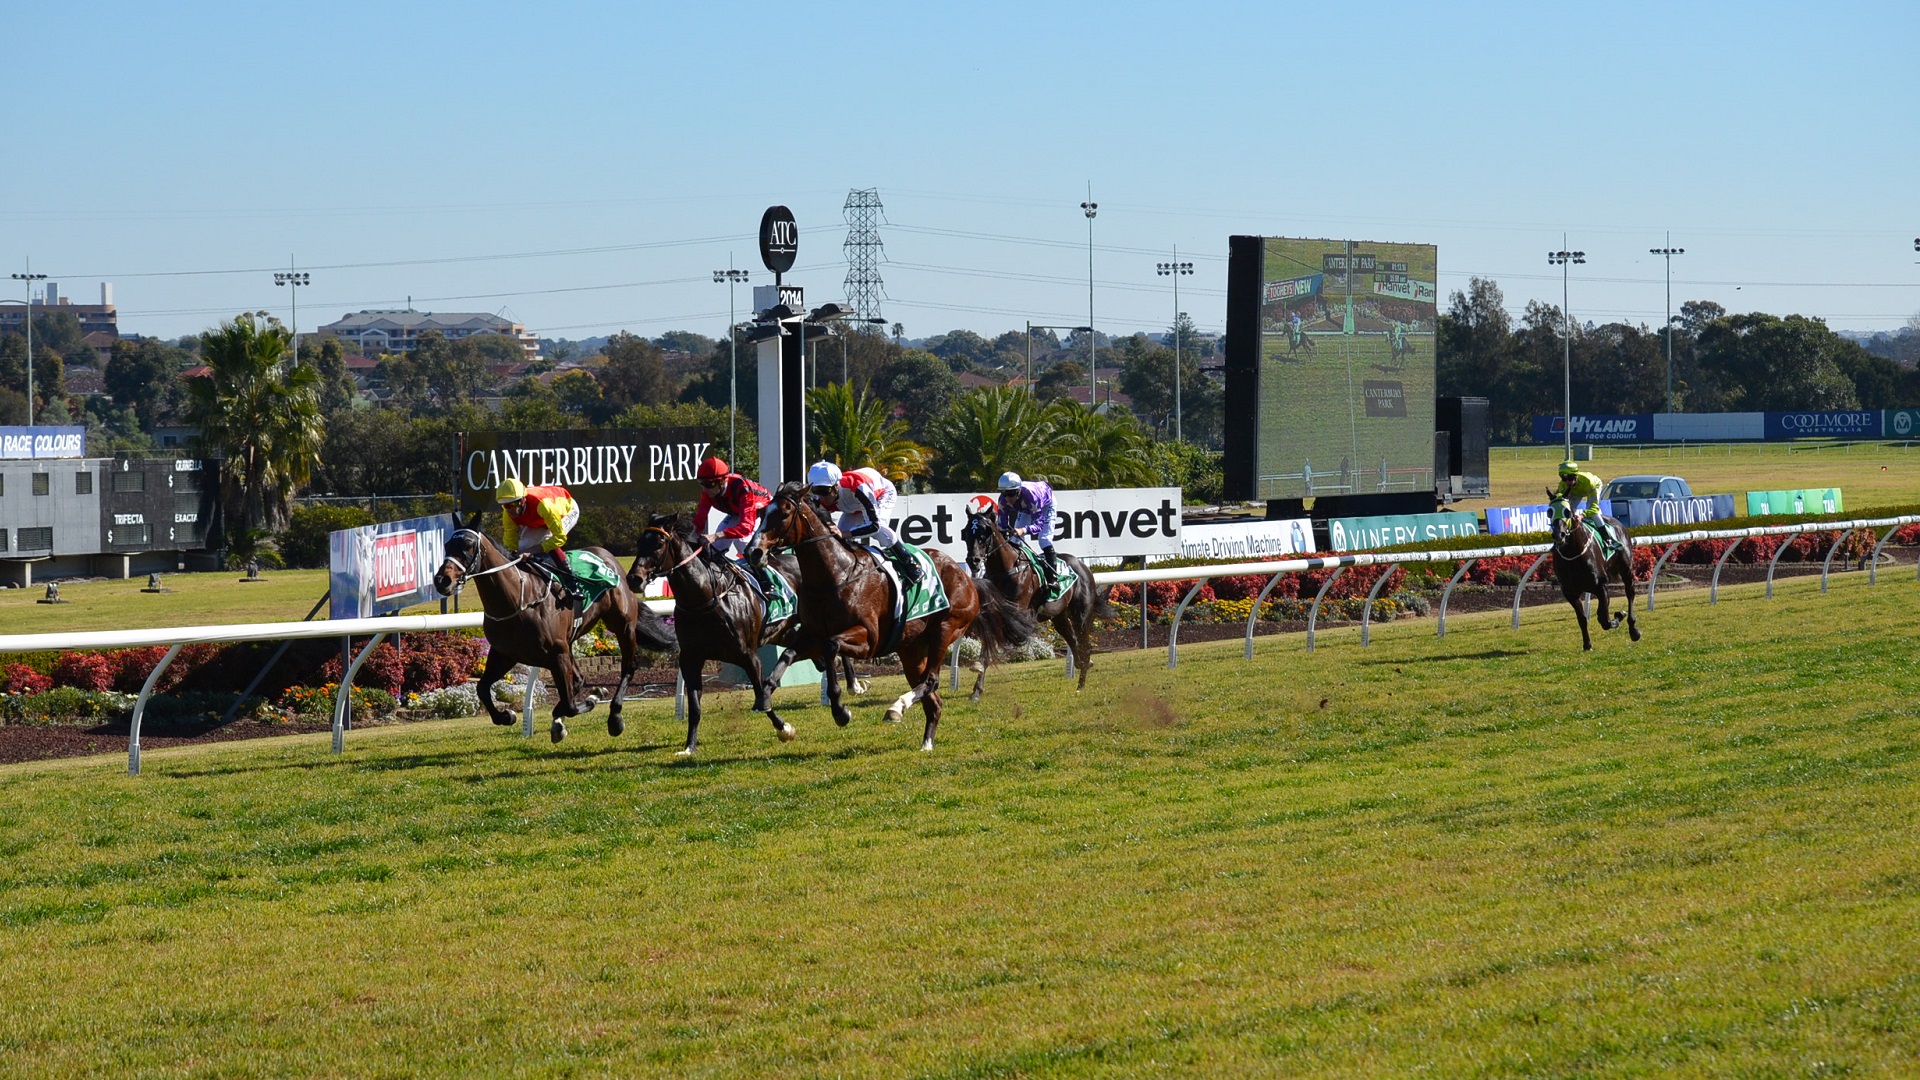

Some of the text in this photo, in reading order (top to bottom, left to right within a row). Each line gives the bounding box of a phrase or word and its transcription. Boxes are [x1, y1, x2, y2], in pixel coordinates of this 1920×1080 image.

[769, 220, 796, 246] ATC
[1294, 278, 1311, 295] NEW
[1418, 285, 1435, 298] Ran
[780, 290, 801, 306] 2014
[1570, 416, 1637, 433] HYLAND
[1781, 413, 1872, 430] COOLMORE
[3, 435, 33, 452] RACE
[34, 434, 82, 452] COLOURS
[1585, 432, 1604, 440] race
[81, 461, 86, 472] 5
[123, 460, 129, 472] 6
[467, 442, 711, 491] CANTERBURY PARK
[168, 475, 174, 488] $
[1652, 498, 1713, 526] COOLMORE
[1823, 499, 1836, 513] TAB
[114, 514, 144, 525] TRIFECTA
[174, 514, 198, 523] EXACTA
[107, 530, 113, 543] $
[169, 527, 175, 541] $
[1349, 526, 1417, 551] VINERY
[1212, 536, 1244, 557] Driving
[1246, 533, 1282, 554] Machine
